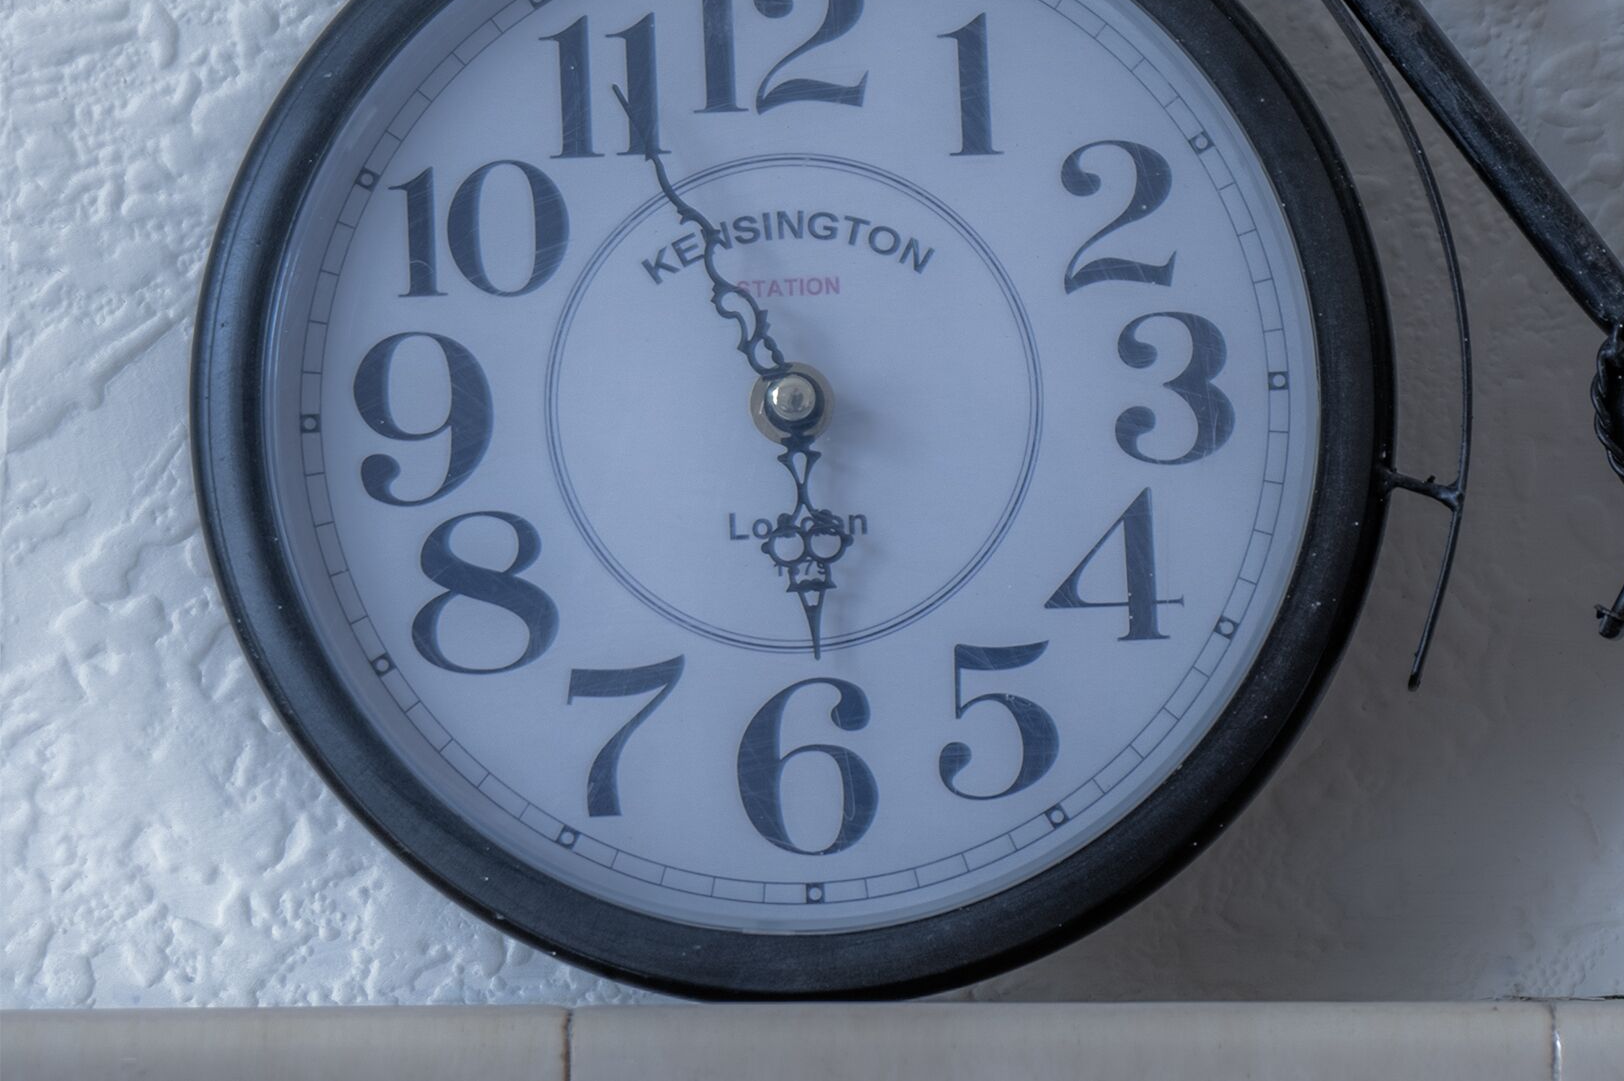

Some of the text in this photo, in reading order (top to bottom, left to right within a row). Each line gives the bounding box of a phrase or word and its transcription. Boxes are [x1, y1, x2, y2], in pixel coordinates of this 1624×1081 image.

[539, 12, 671, 160] 11
[937, 12, 1004, 157] 1
[388, 159, 570, 298] 10
[641, 209, 935, 285] KENSINGTON
[735, 276, 841, 298] STATION
[1060, 139, 1178, 294] 2
[352, 331, 494, 506] 9
[1115, 311, 1235, 465] 3
[411, 511, 560, 675] 8
[728, 512, 868, 540] Loon
[773, 555, 828, 577] 179
[1043, 486, 1185, 642] 4
[566, 654, 685, 818] 7
[736, 677, 879, 856] 6
[937, 640, 1060, 801] 5
